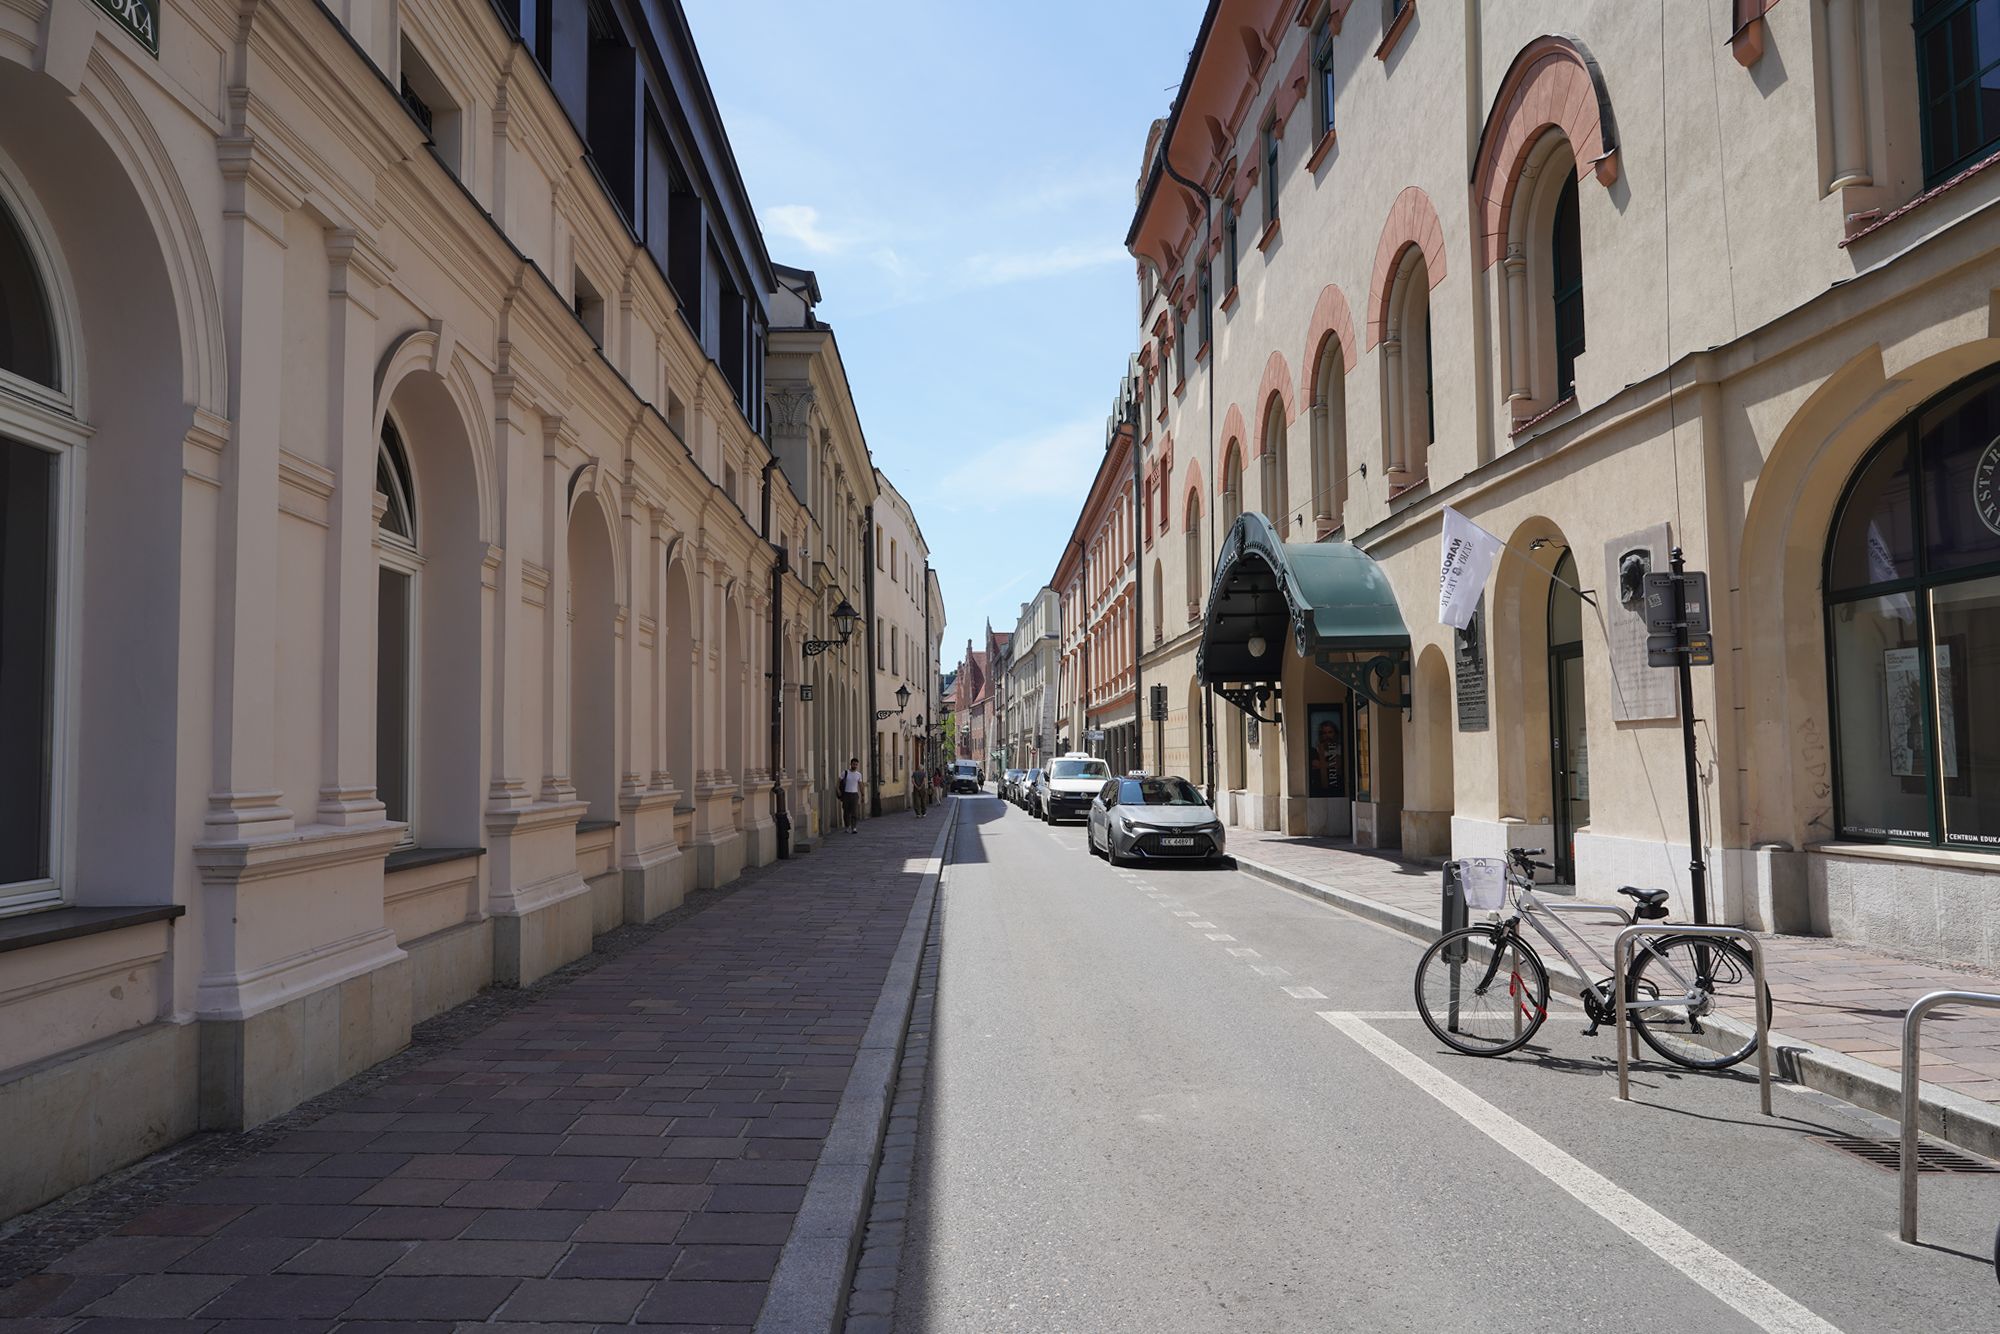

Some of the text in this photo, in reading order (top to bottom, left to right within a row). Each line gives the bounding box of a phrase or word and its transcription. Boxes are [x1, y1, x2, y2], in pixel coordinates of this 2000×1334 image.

[1864, 827, 1886, 835] MUZEUM
[1887, 828, 1930, 838] INTERAKTYWNE
[1949, 833, 1979, 842] CENTRUM
